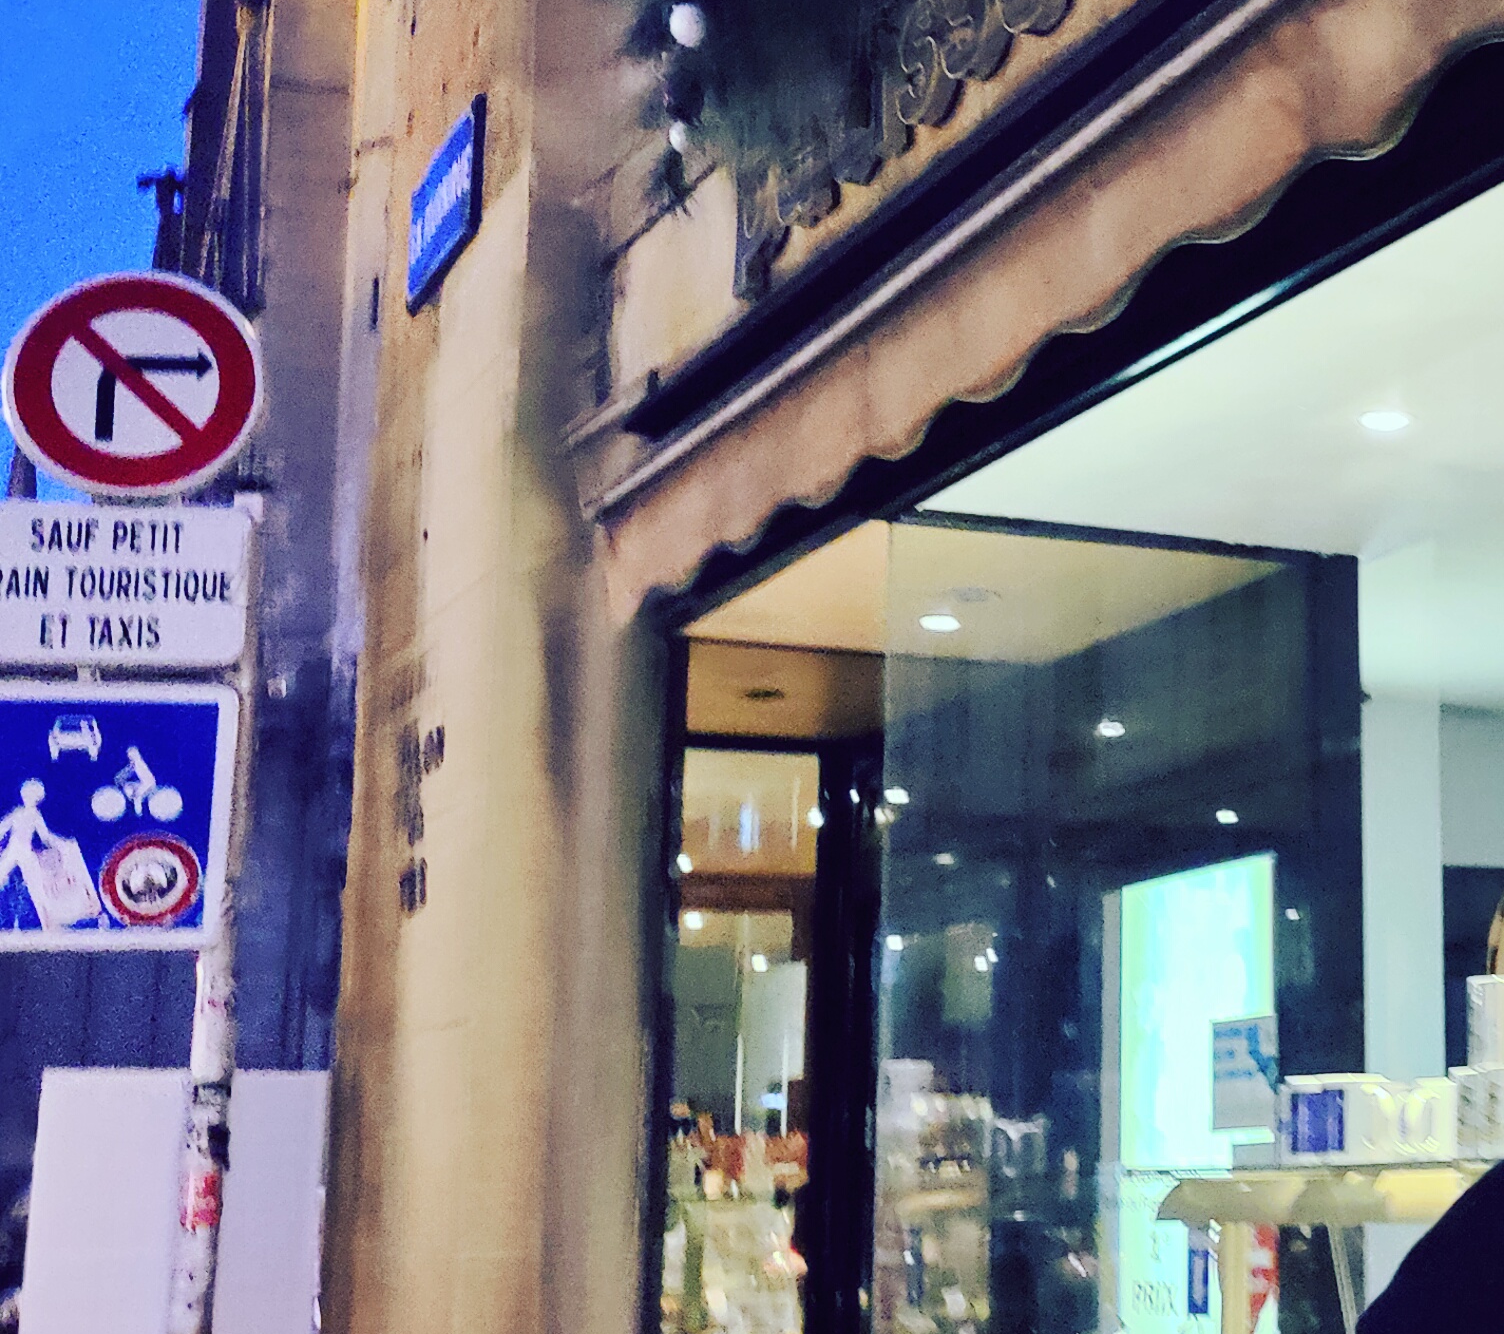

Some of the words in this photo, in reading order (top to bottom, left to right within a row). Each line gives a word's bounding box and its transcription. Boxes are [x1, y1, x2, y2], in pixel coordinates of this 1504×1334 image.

[30, 517, 99, 553] SAUF
[112, 519, 184, 554] PETIT
[0, 565, 49, 599] AIN
[66, 565, 232, 604] TOURISTIQUE
[40, 612, 70, 650] ET
[87, 614, 161, 650] TAXIS
